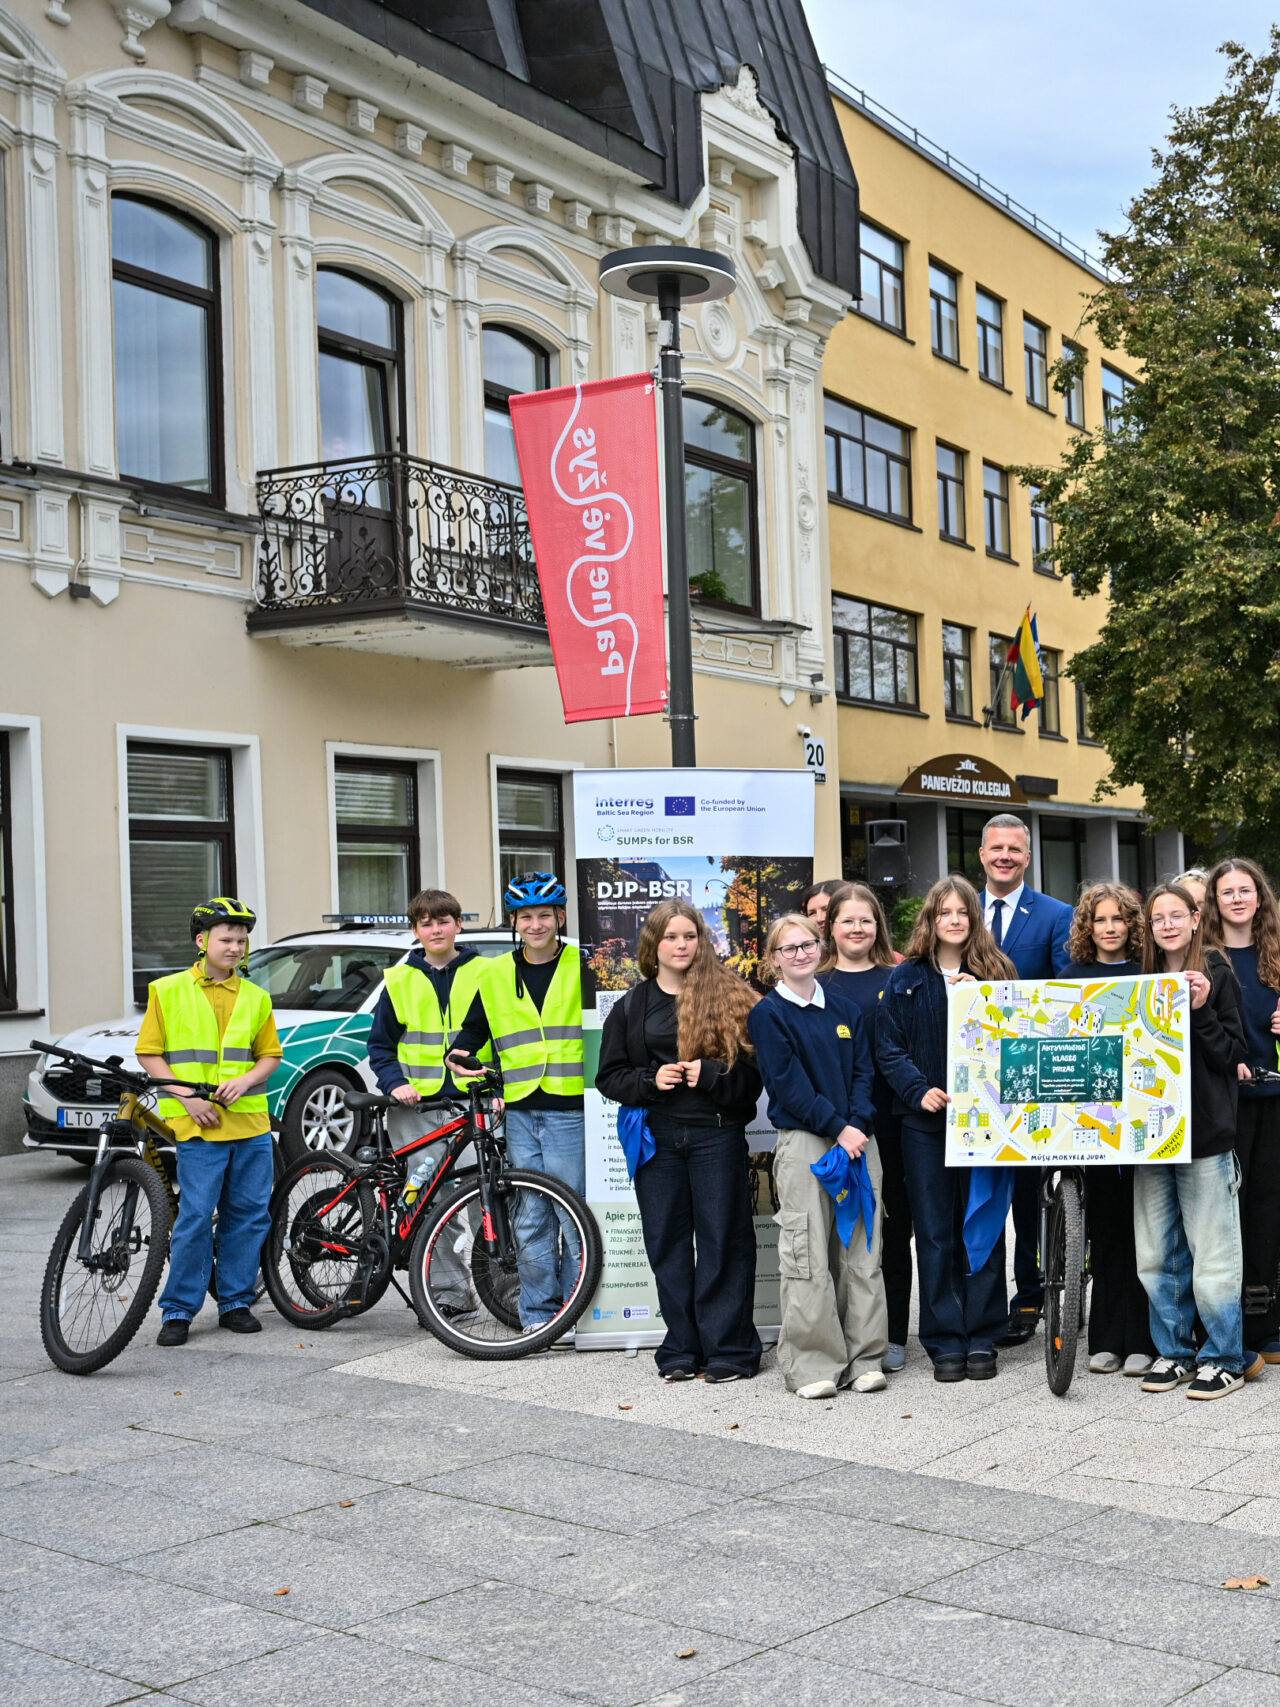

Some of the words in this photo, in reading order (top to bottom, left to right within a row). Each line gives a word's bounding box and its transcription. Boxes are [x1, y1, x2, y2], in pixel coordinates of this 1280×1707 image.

[806, 743, 825, 767] 20
[921, 774, 971, 794] PANEVĖŽIO
[972, 780, 1012, 798] KOLEGIJA
[595, 796, 655, 809] Interreg
[630, 809, 655, 817] Region
[616, 836, 653, 846] SUMPs
[655, 836, 671, 845] for
[672, 836, 694, 845] BSR
[597, 880, 692, 899] DJP-BSR
[65, 1111, 94, 1127] LTO
[605, 1211, 625, 1223] Apie
[607, 1261, 650, 1269] PARTNERIAI:
